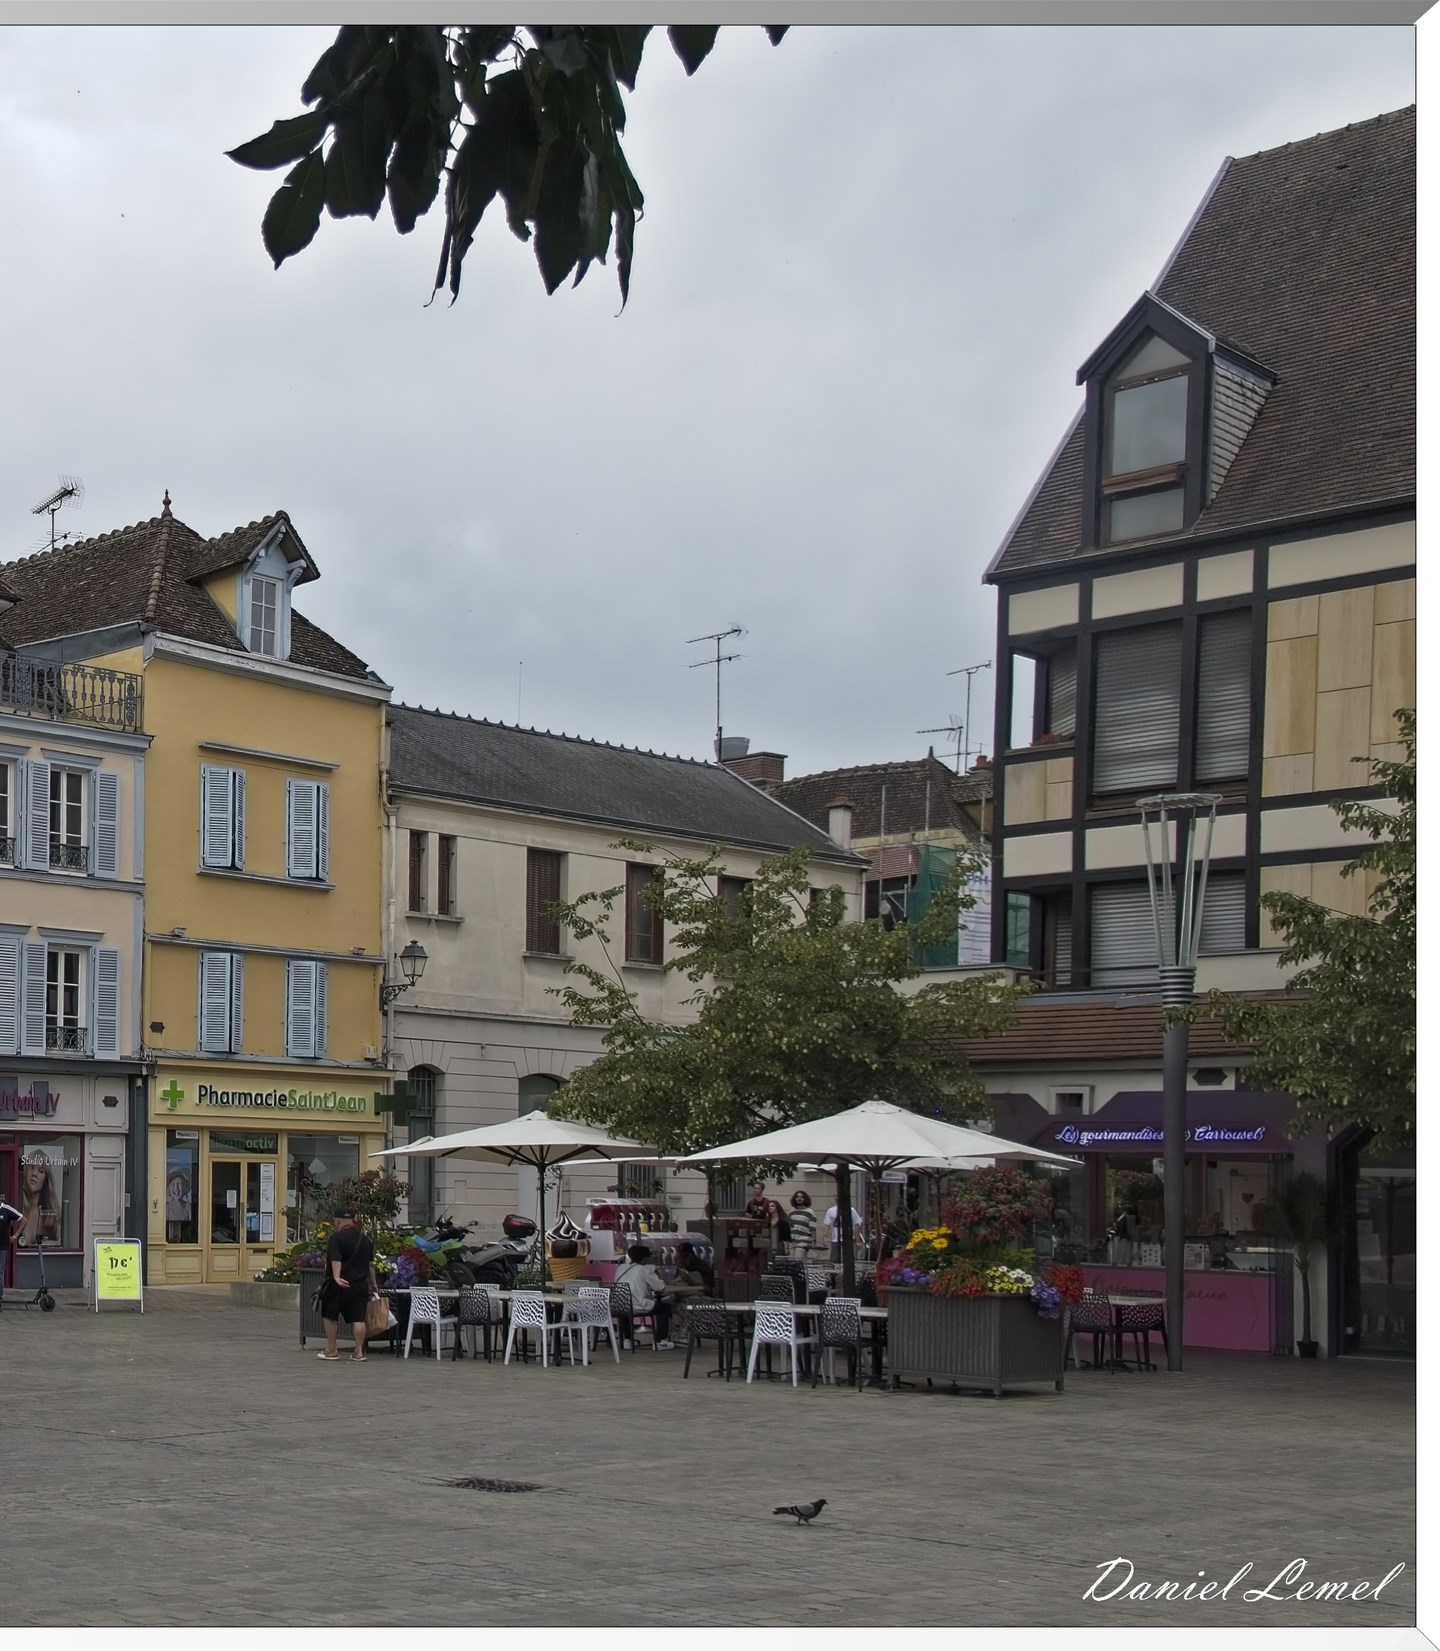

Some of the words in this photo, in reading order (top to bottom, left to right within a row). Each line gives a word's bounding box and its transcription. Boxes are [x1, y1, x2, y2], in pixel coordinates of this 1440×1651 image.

[21, 1155, 43, 1166] Studio
[45, 1155, 68, 1166] Urbain
[69, 1157, 79, 1167] IV
